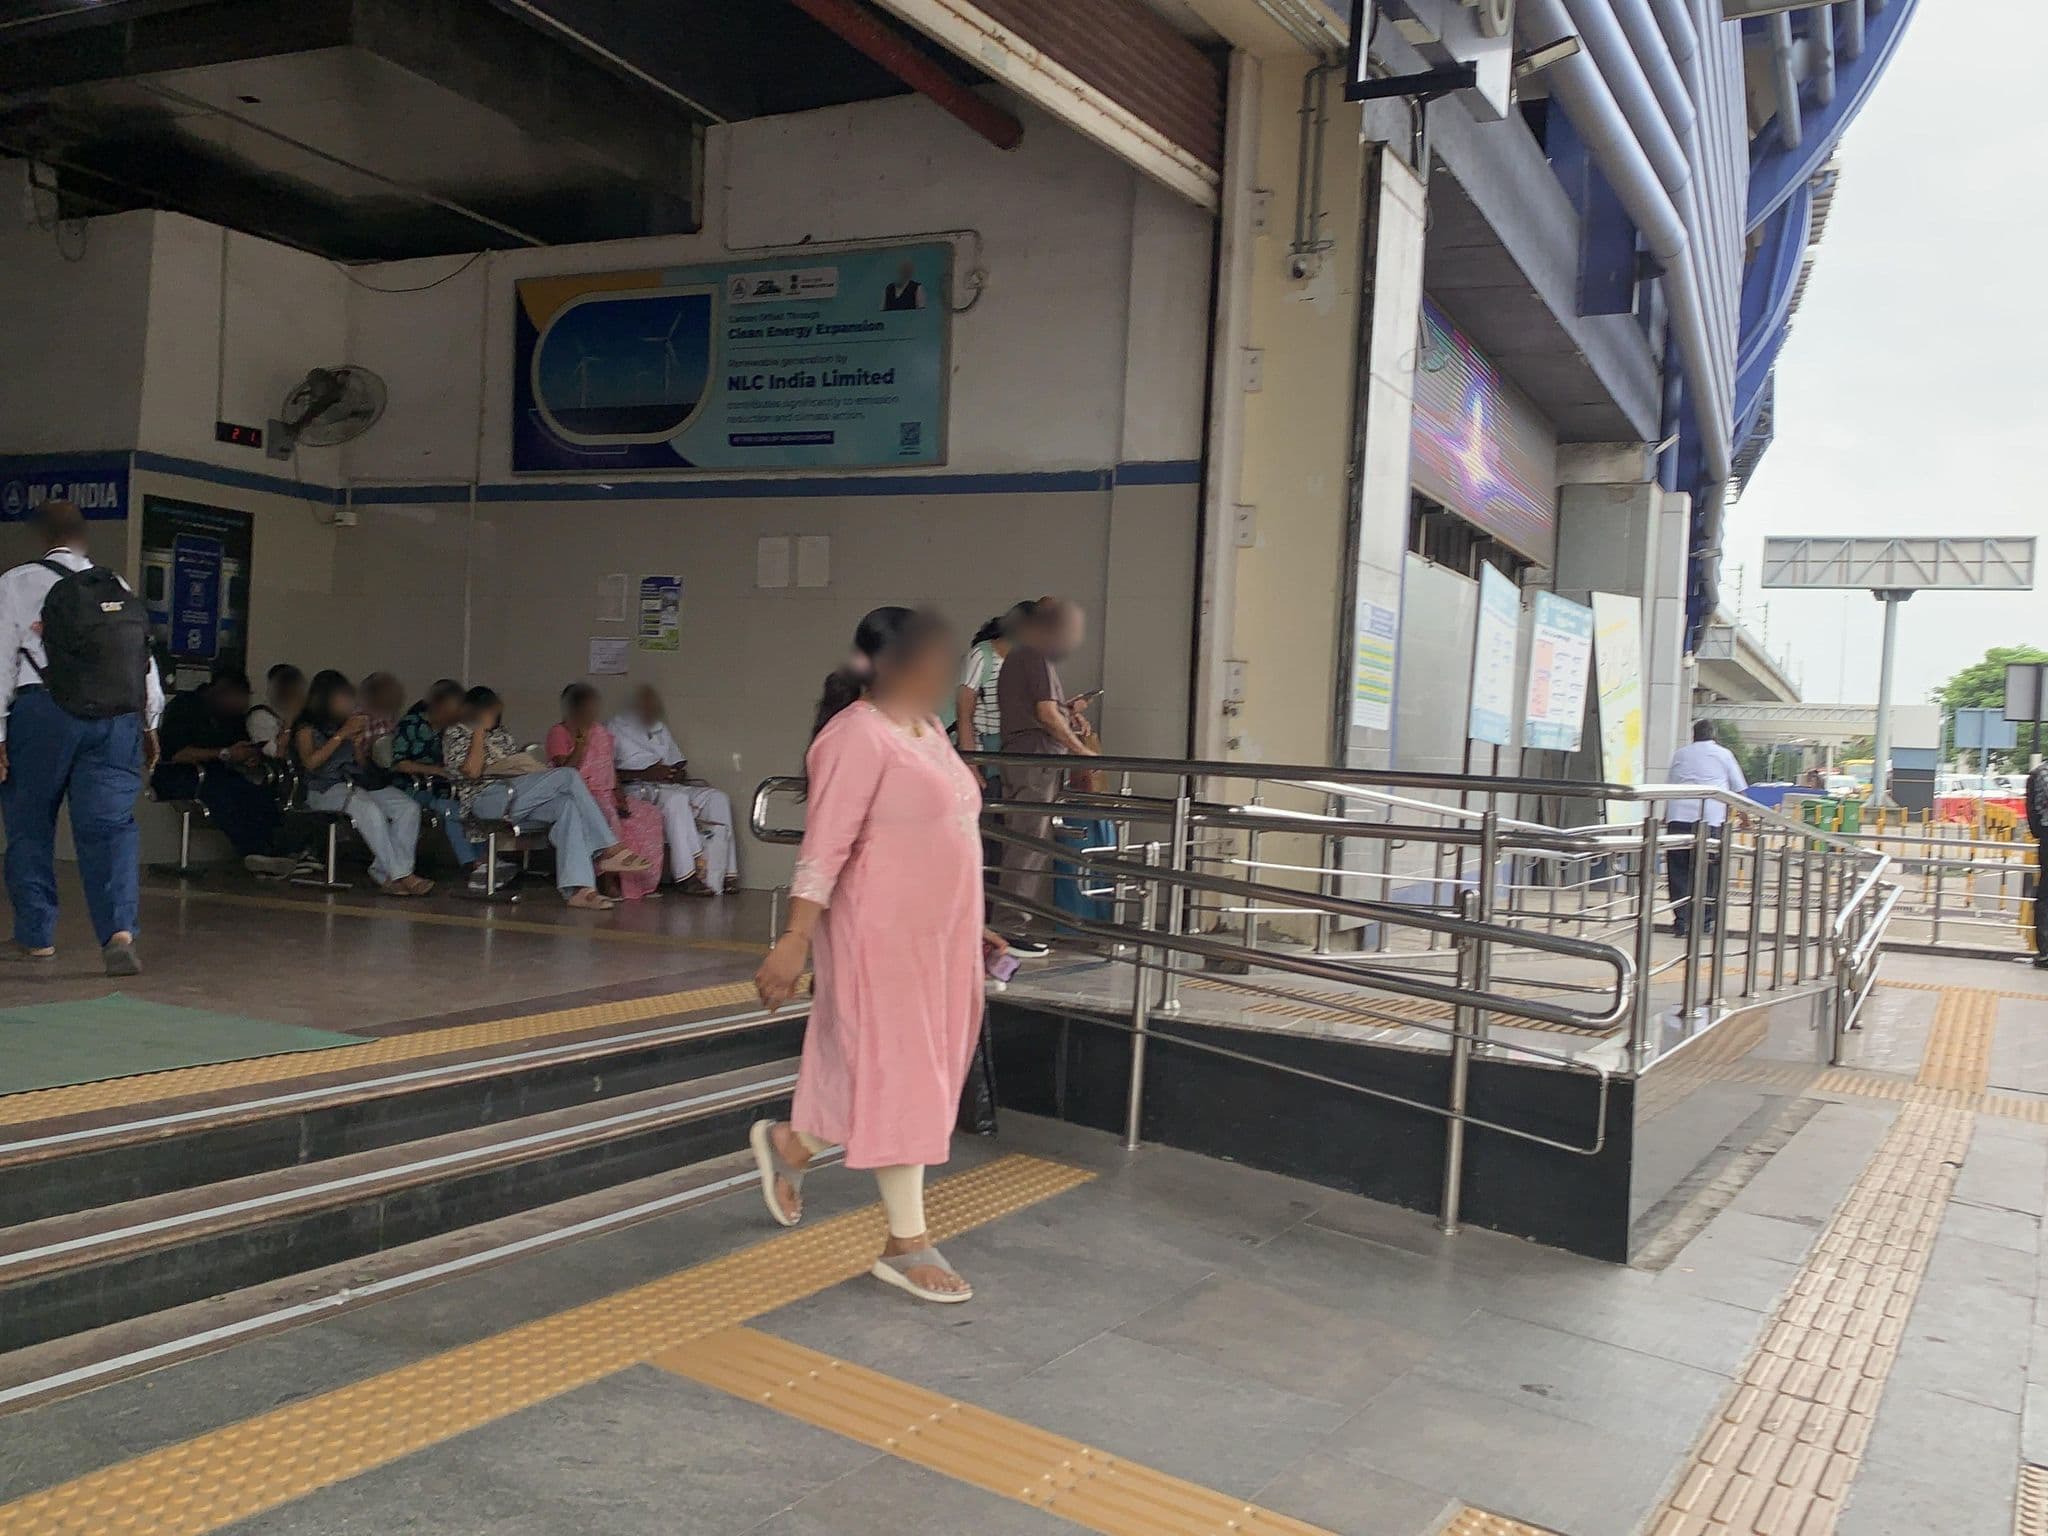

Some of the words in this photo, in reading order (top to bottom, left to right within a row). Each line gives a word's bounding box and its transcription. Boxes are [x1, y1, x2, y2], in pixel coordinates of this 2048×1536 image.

[728, 327, 763, 339] Clean
[766, 324, 812, 338] Energy
[816, 319, 885, 336] Expansion
[728, 374, 764, 391] NLC
[769, 370, 816, 389] India
[822, 367, 896, 387] Limited
[68, 481, 118, 508] INDIA
